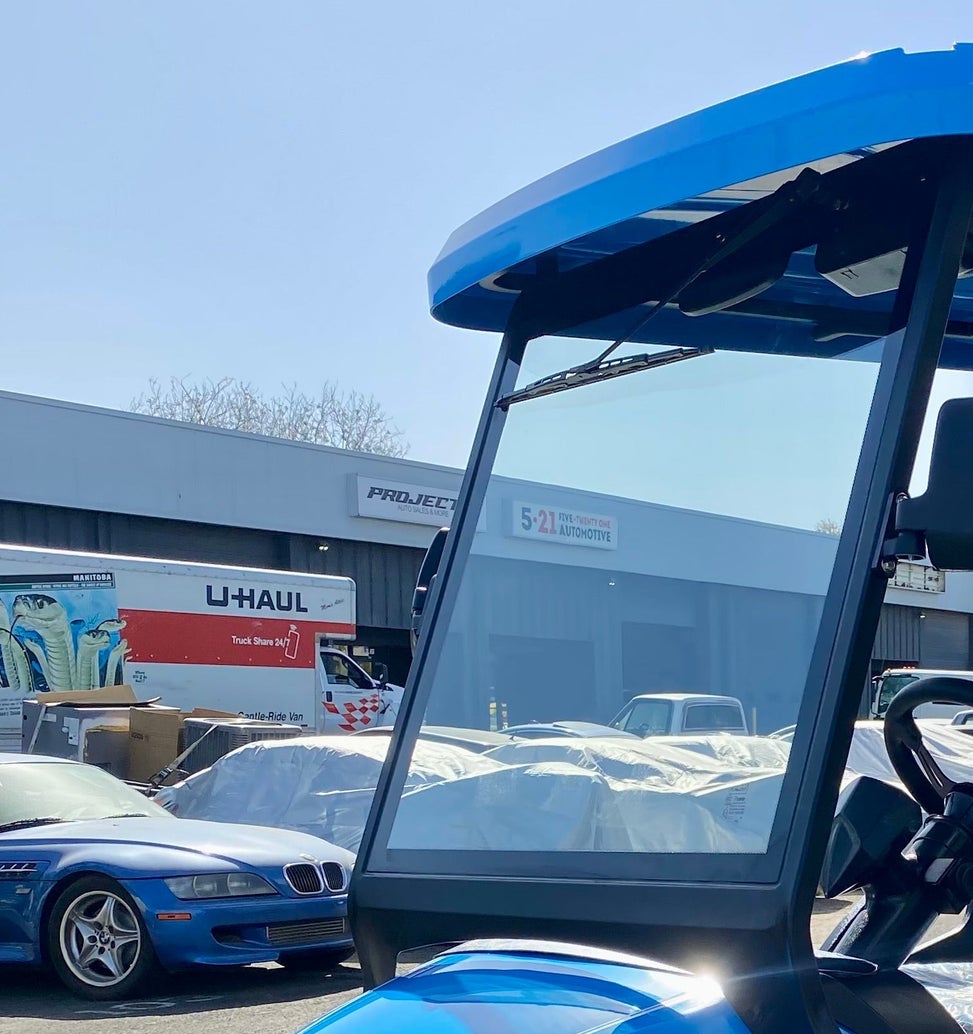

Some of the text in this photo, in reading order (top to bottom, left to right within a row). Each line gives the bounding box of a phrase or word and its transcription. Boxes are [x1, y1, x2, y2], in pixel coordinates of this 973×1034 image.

[366, 486, 459, 511] PROJECT
[398, 504, 412, 513] AUTO
[413, 506, 428, 515] SALES
[434, 509, 449, 518] MORE
[558, 525, 611, 543] AUTOMOTIVE
[73, 573, 112, 582] MANITOBA
[206, 585, 308, 613] U-HAUL
[231, 635, 291, 648] Truck Share 24/7
[289, 711, 304, 721] Van
